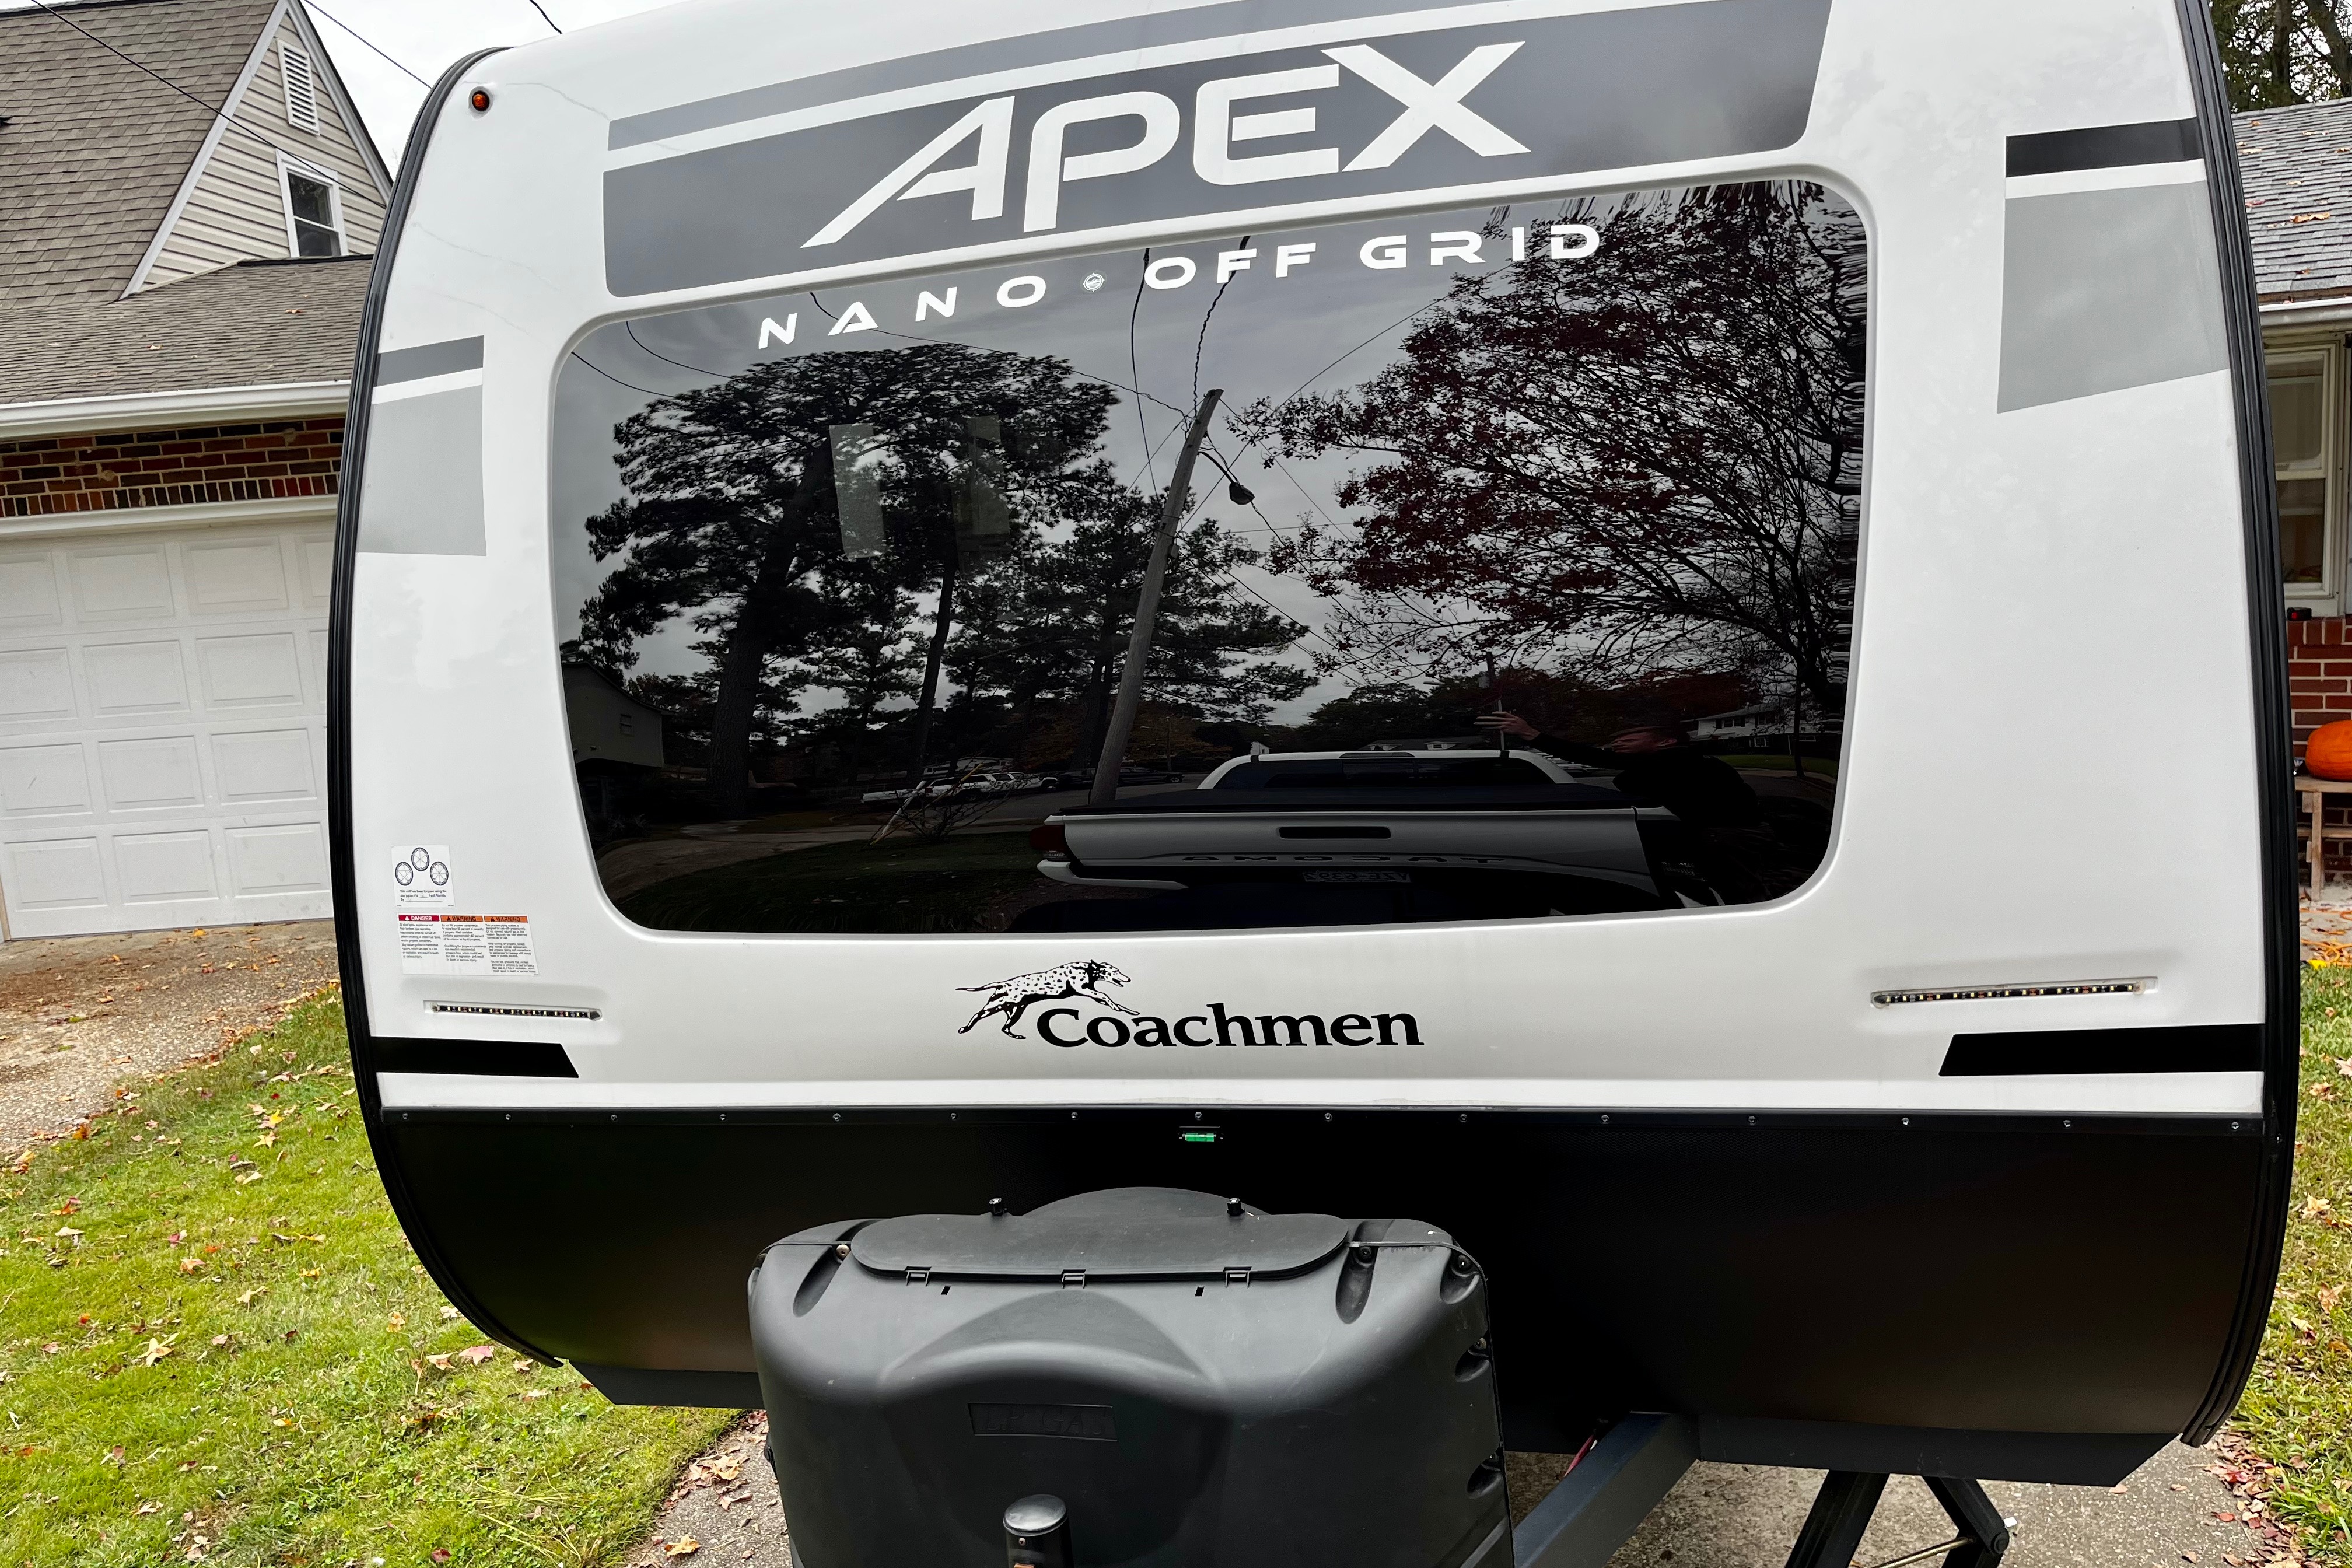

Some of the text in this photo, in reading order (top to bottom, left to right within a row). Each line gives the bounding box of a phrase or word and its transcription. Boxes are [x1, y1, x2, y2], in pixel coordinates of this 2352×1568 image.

[800, 41, 1531, 249] APEX
[758, 225, 1601, 349] NANO OFF GRID
[1037, 1002, 1424, 1048] Coachmen
